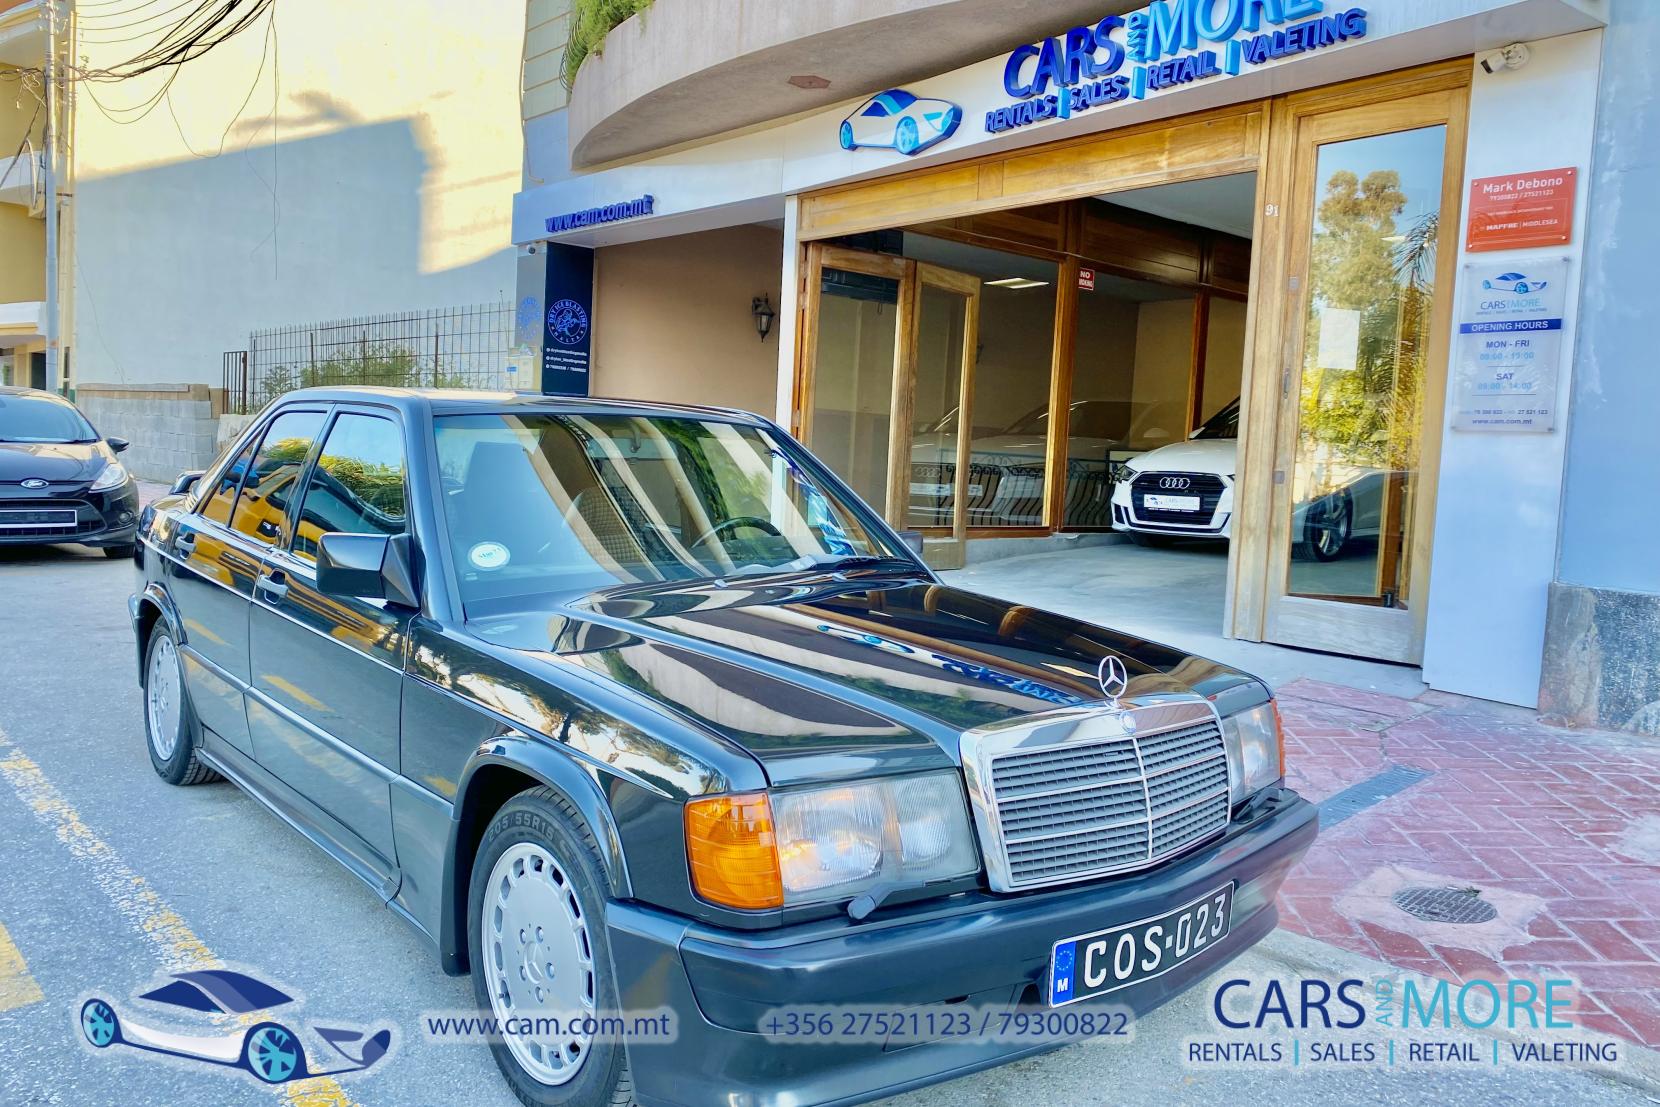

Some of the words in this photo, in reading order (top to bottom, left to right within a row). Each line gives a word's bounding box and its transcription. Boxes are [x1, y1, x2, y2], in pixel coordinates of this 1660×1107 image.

[1004, 15, 1128, 98] CARS
[1126, 13, 1149, 64] AND
[985, 93, 1060, 133] RENTALS
[1068, 75, 1130, 113] SALES
[1146, 50, 1222, 92] RETAIL
[1241, 7, 1368, 65] VALETING
[1483, 180, 1513, 194] Mark
[1517, 177, 1563, 190] Debono
[545, 194, 655, 233] www.cam.com.mt
[1265, 204, 1279, 217] 91
[1480, 300, 1506, 310] CARS
[1471, 322, 1513, 332] OPENING
[1514, 320, 1549, 330] HOURS
[1486, 340, 1507, 349] MON
[1515, 339, 1530, 348] FRI
[1496, 372, 1514, 381] SAT
[1057, 977, 1068, 992] M
